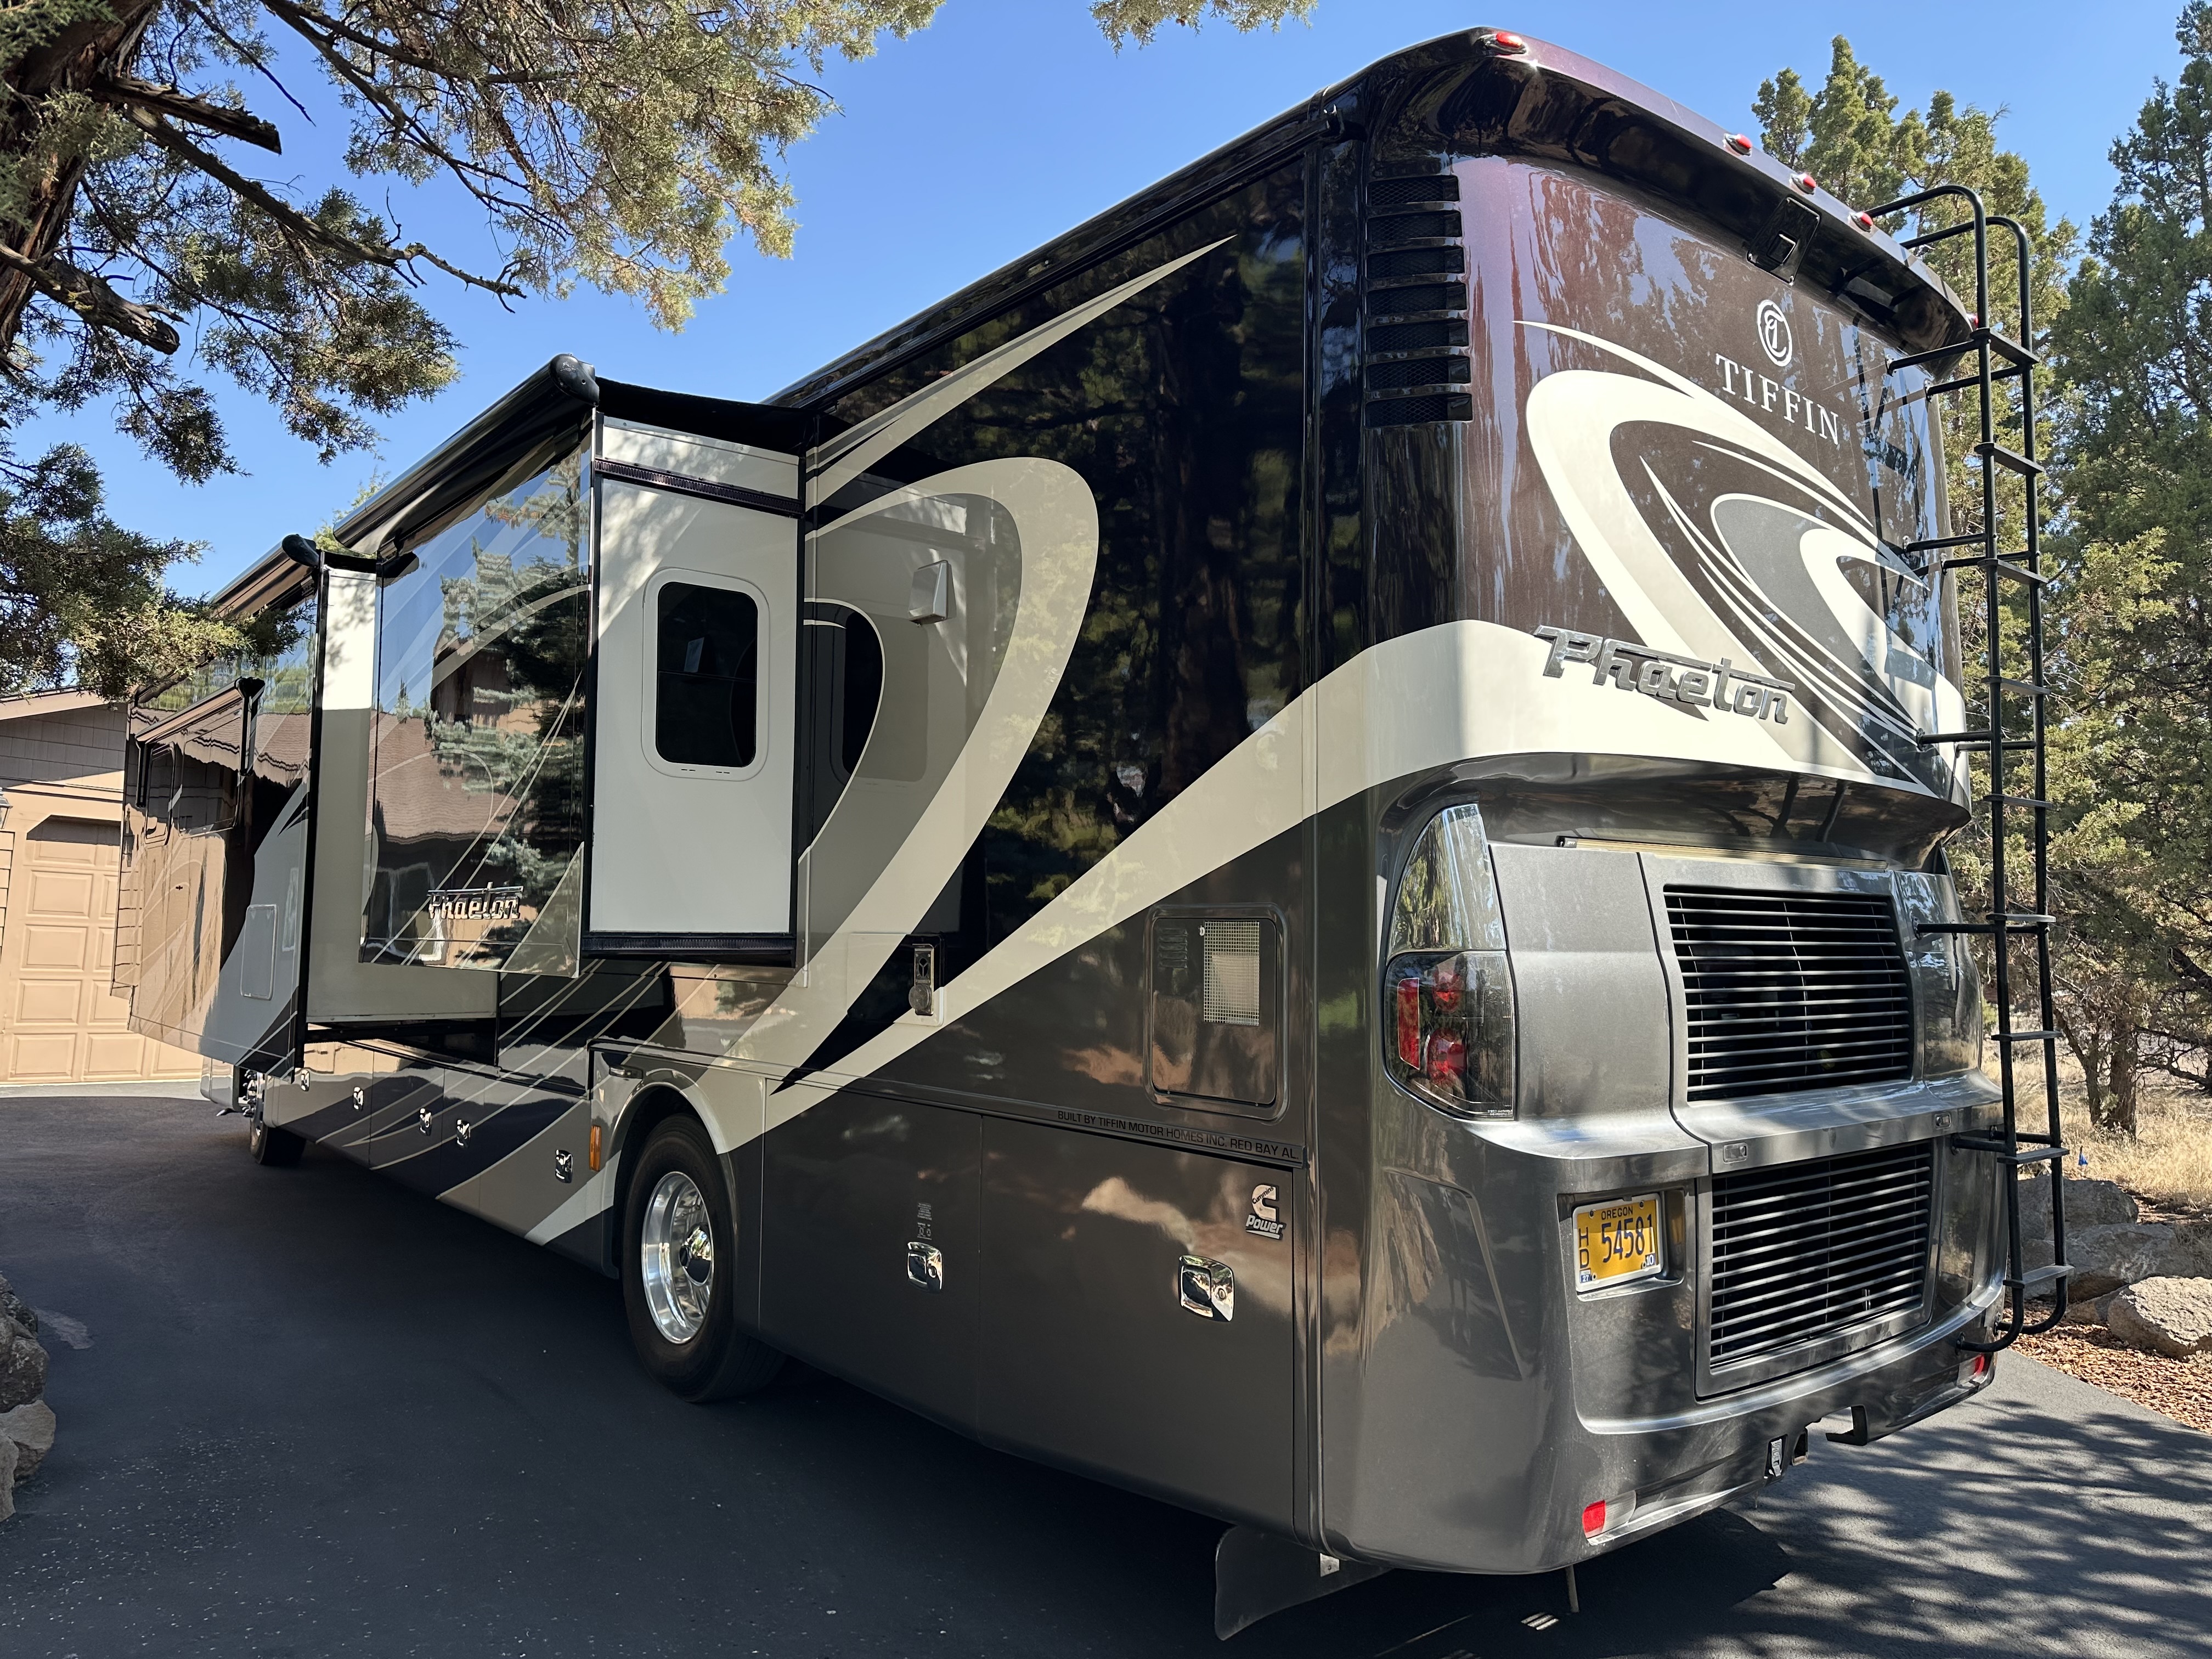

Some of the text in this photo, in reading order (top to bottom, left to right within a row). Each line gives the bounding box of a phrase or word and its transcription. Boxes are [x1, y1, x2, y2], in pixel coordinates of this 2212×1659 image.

[1716, 353, 1838, 445] TIFFIN
[1534, 625, 1796, 725] Phaeton
[427, 882, 524, 919] Phaeton
[1058, 1110, 1299, 1159] BUILT BY TIFFIN MOTOR HOMES INC. RED BAY AL.
[1252, 1187, 1274, 1204] Cummins
[1601, 1206, 1633, 1220] OREGON
[1601, 1214, 1654, 1263] 54581
[1646, 1254, 1654, 1266] 10
